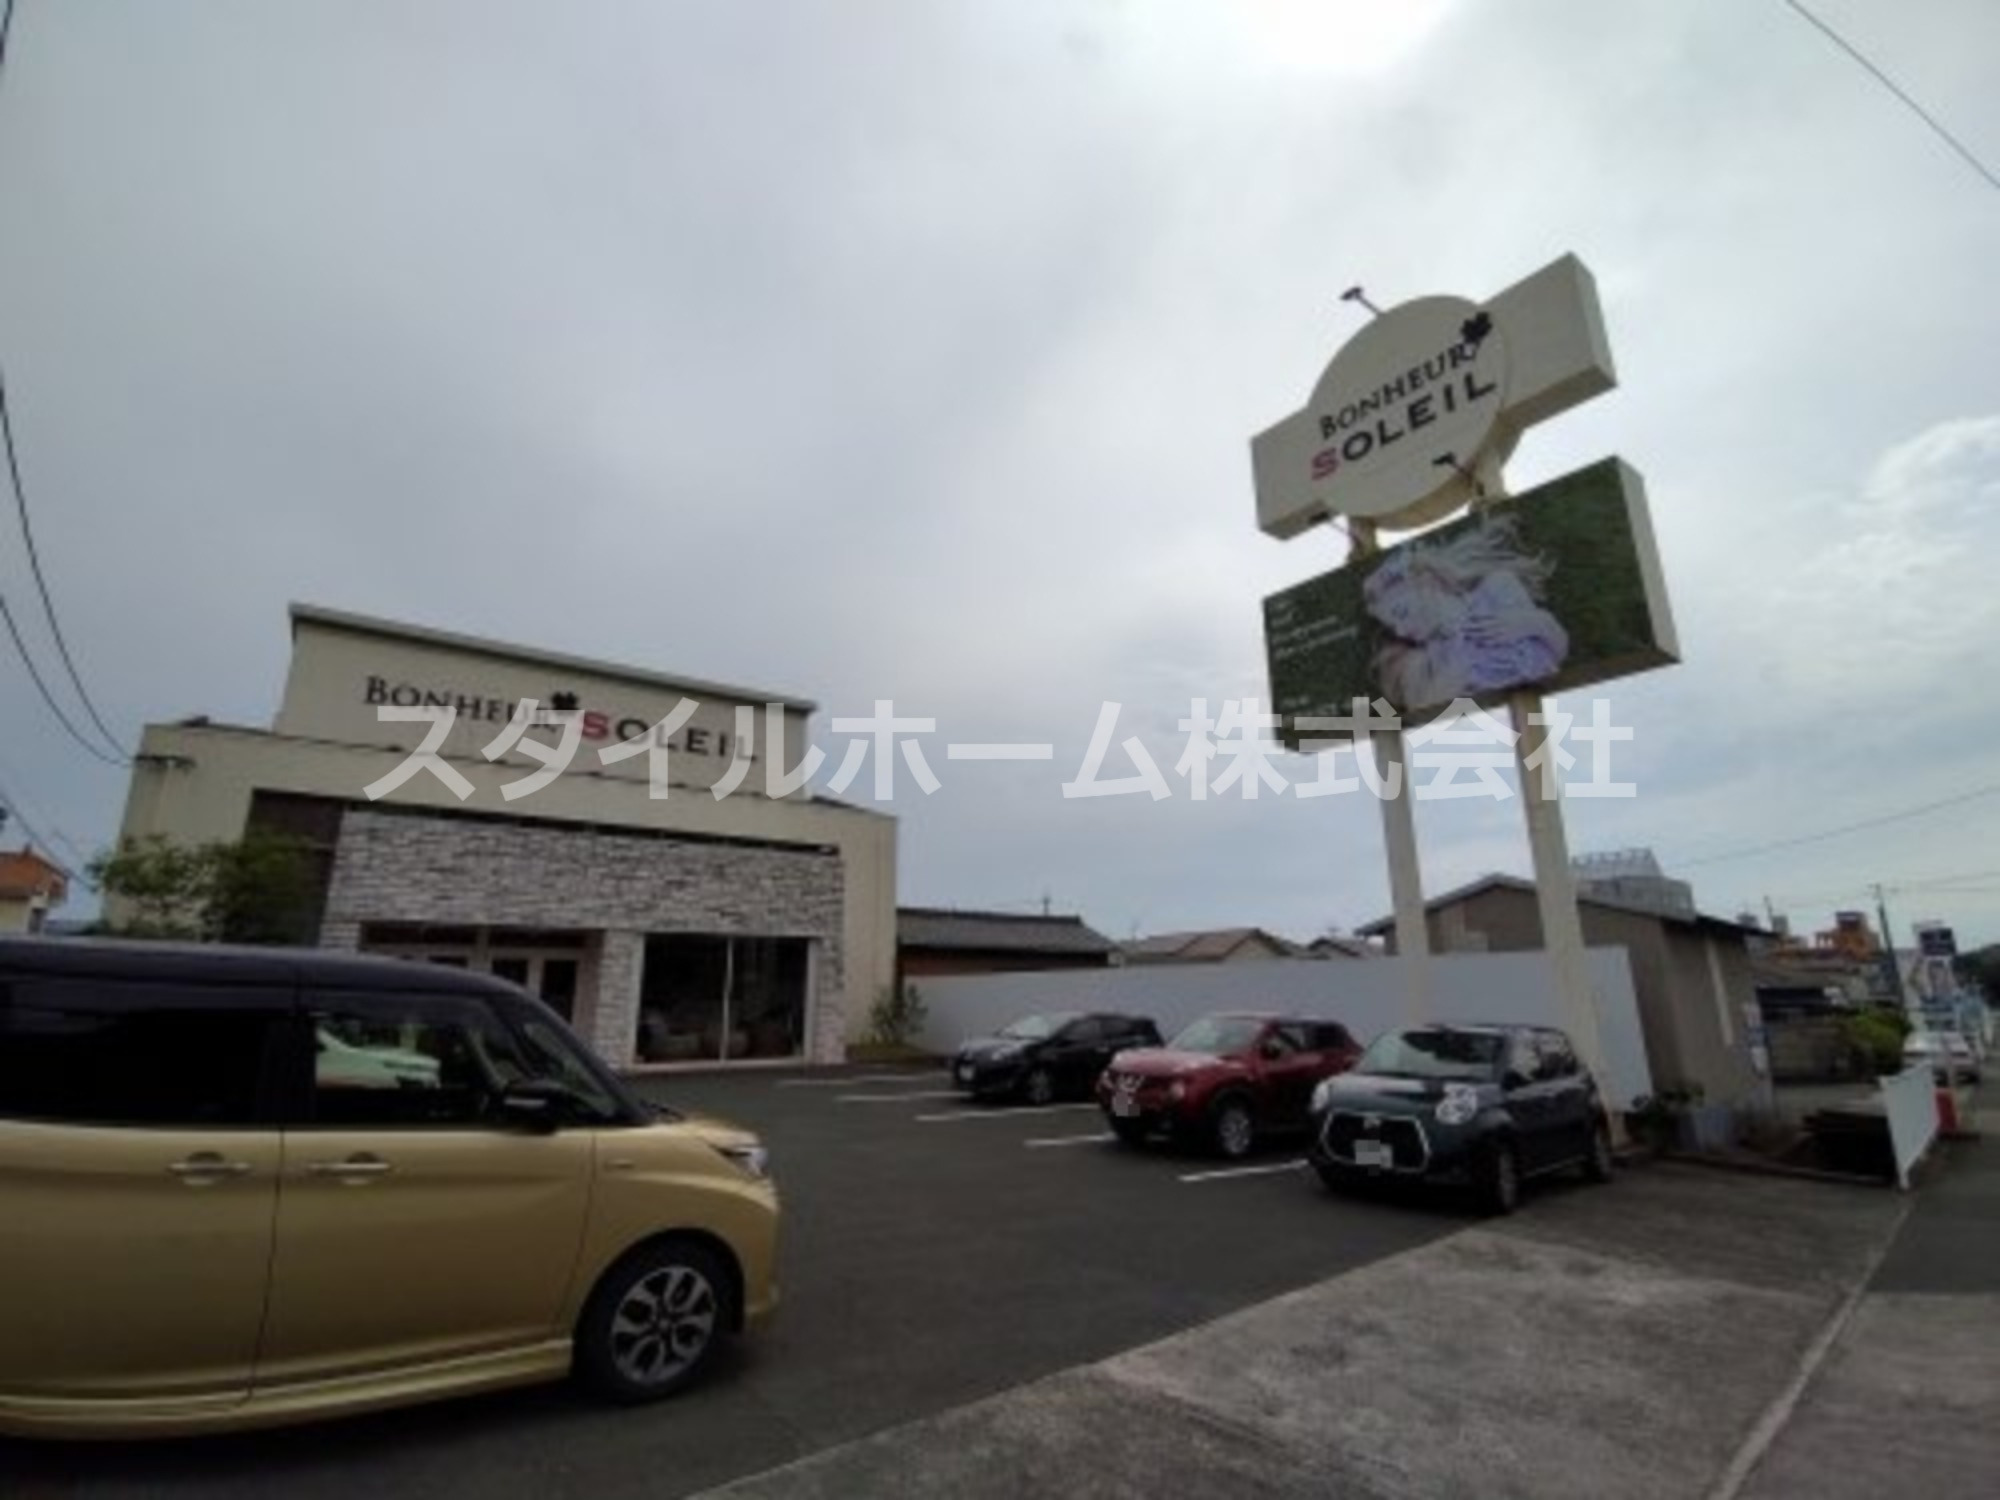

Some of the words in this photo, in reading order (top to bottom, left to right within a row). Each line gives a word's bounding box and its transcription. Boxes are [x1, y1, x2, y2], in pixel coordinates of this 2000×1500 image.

[1311, 372, 1496, 481] SOLEIL
[1319, 342, 1478, 440] BONHEUR
[366, 676, 558, 734] BONHEUR
[577, 711, 757, 762] SOLEIL
